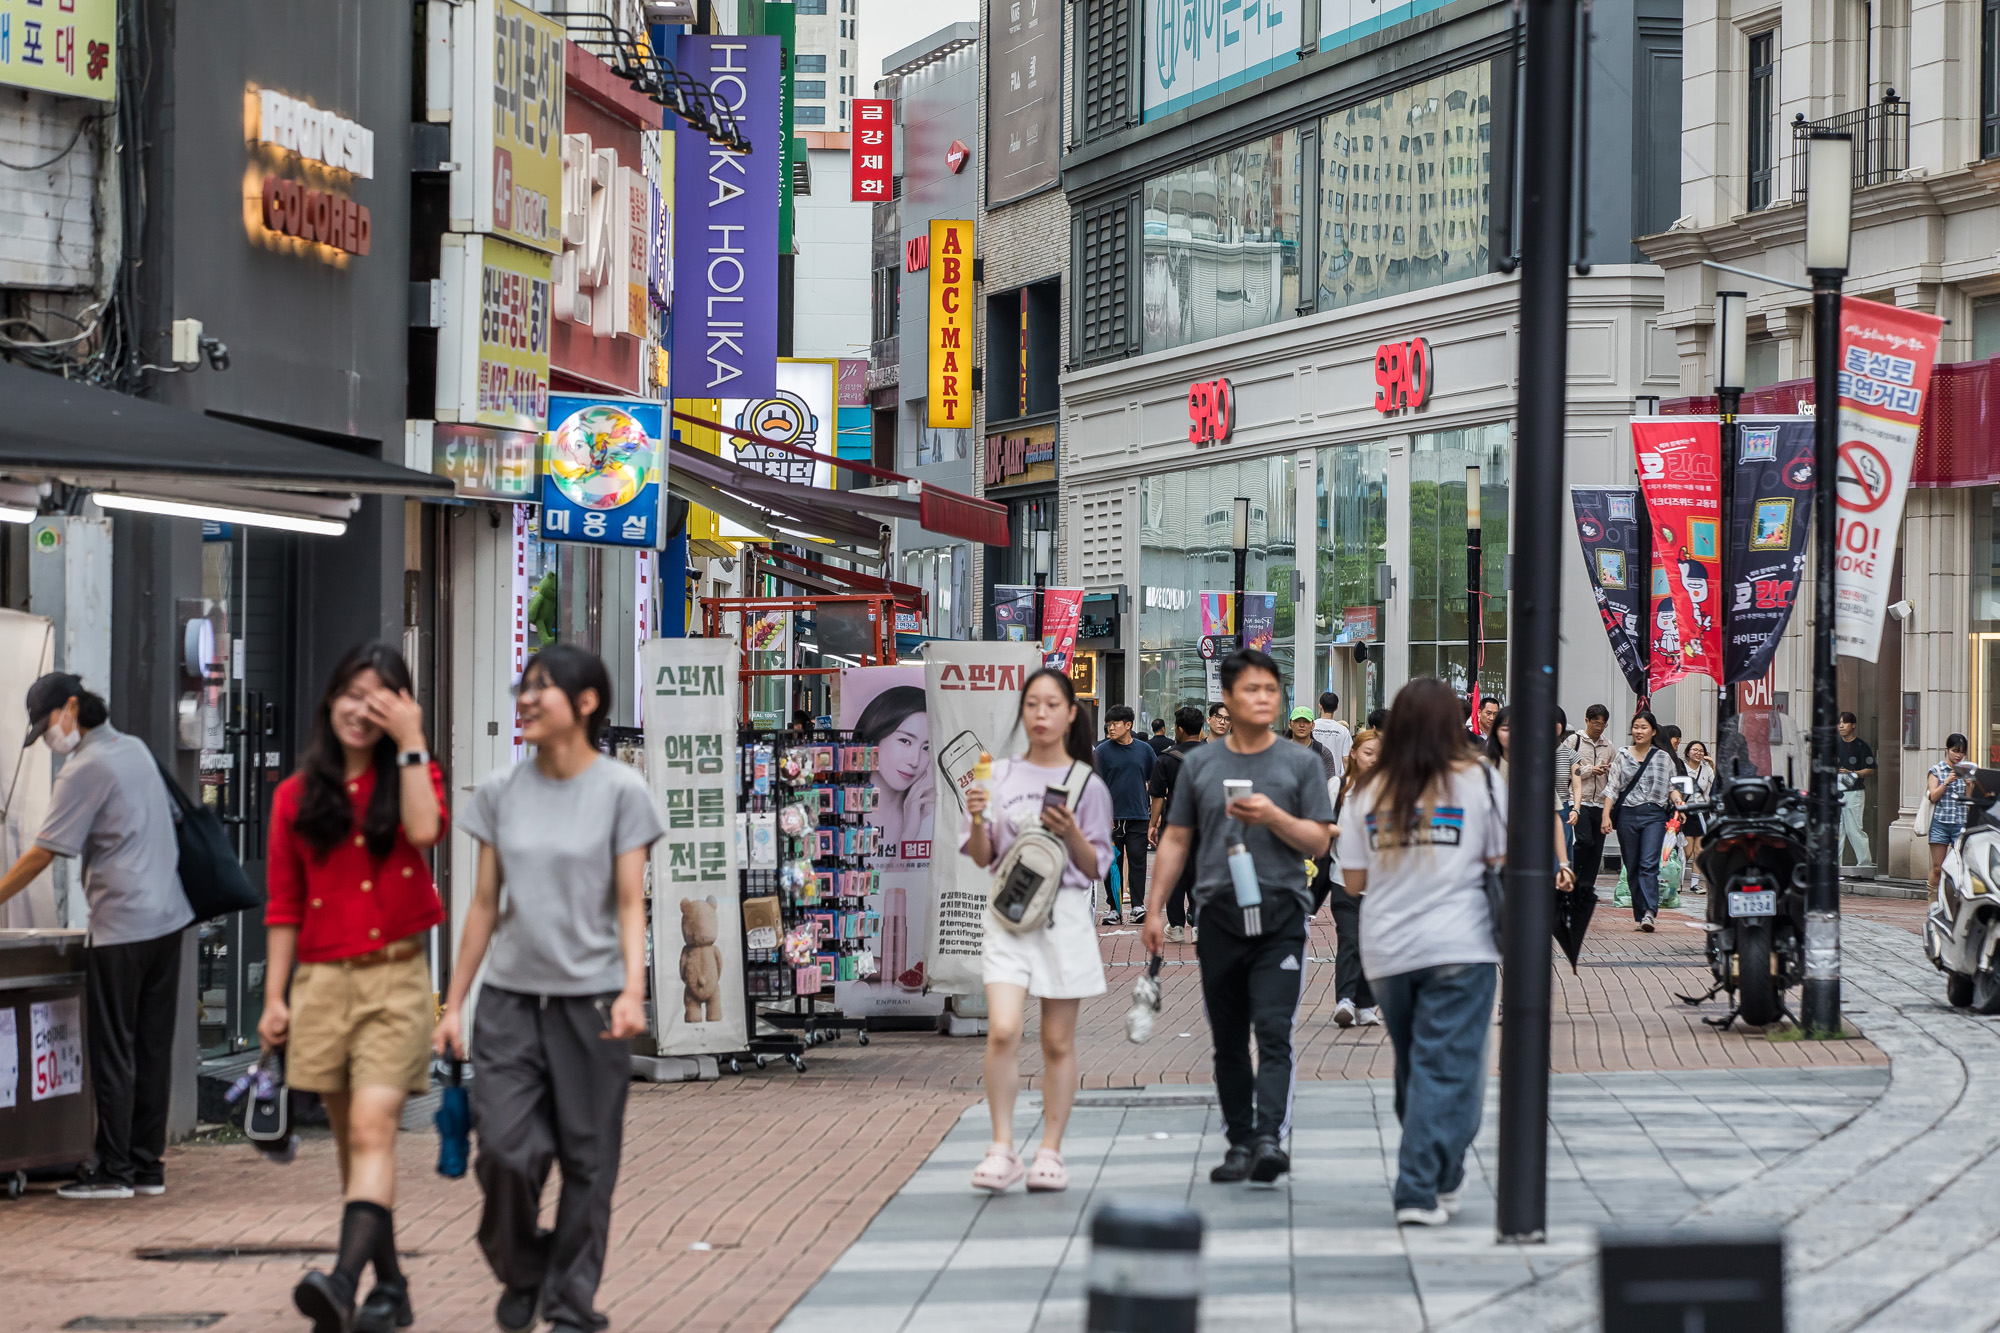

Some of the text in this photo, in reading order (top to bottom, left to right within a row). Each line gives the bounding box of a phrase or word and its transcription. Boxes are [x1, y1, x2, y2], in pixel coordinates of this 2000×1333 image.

[87, 40, 109, 80] 3F
[860, 105, 885, 195] 금강제화
[495, 156, 512, 222] 4F
[262, 174, 371, 256] COLORED
[706, 225, 745, 389] HOLIKA
[941, 228, 962, 420] ABC-MART
[1375, 337, 1427, 414] SPAO
[1847, 347, 1914, 384] 동성로
[1188, 377, 1231, 445] SPAO
[984, 436, 1026, 484] ABC-MART
[546, 508, 647, 540] 미용실
[656, 665, 725, 696] 스펀지
[940, 664, 1025, 691] 스펀지
[665, 734, 724, 774] 액정
[667, 788, 725, 828] 필름
[669, 842, 727, 882] 전문
[905, 843, 930, 857] 멀티
[939, 948, 982, 956] #camerale
